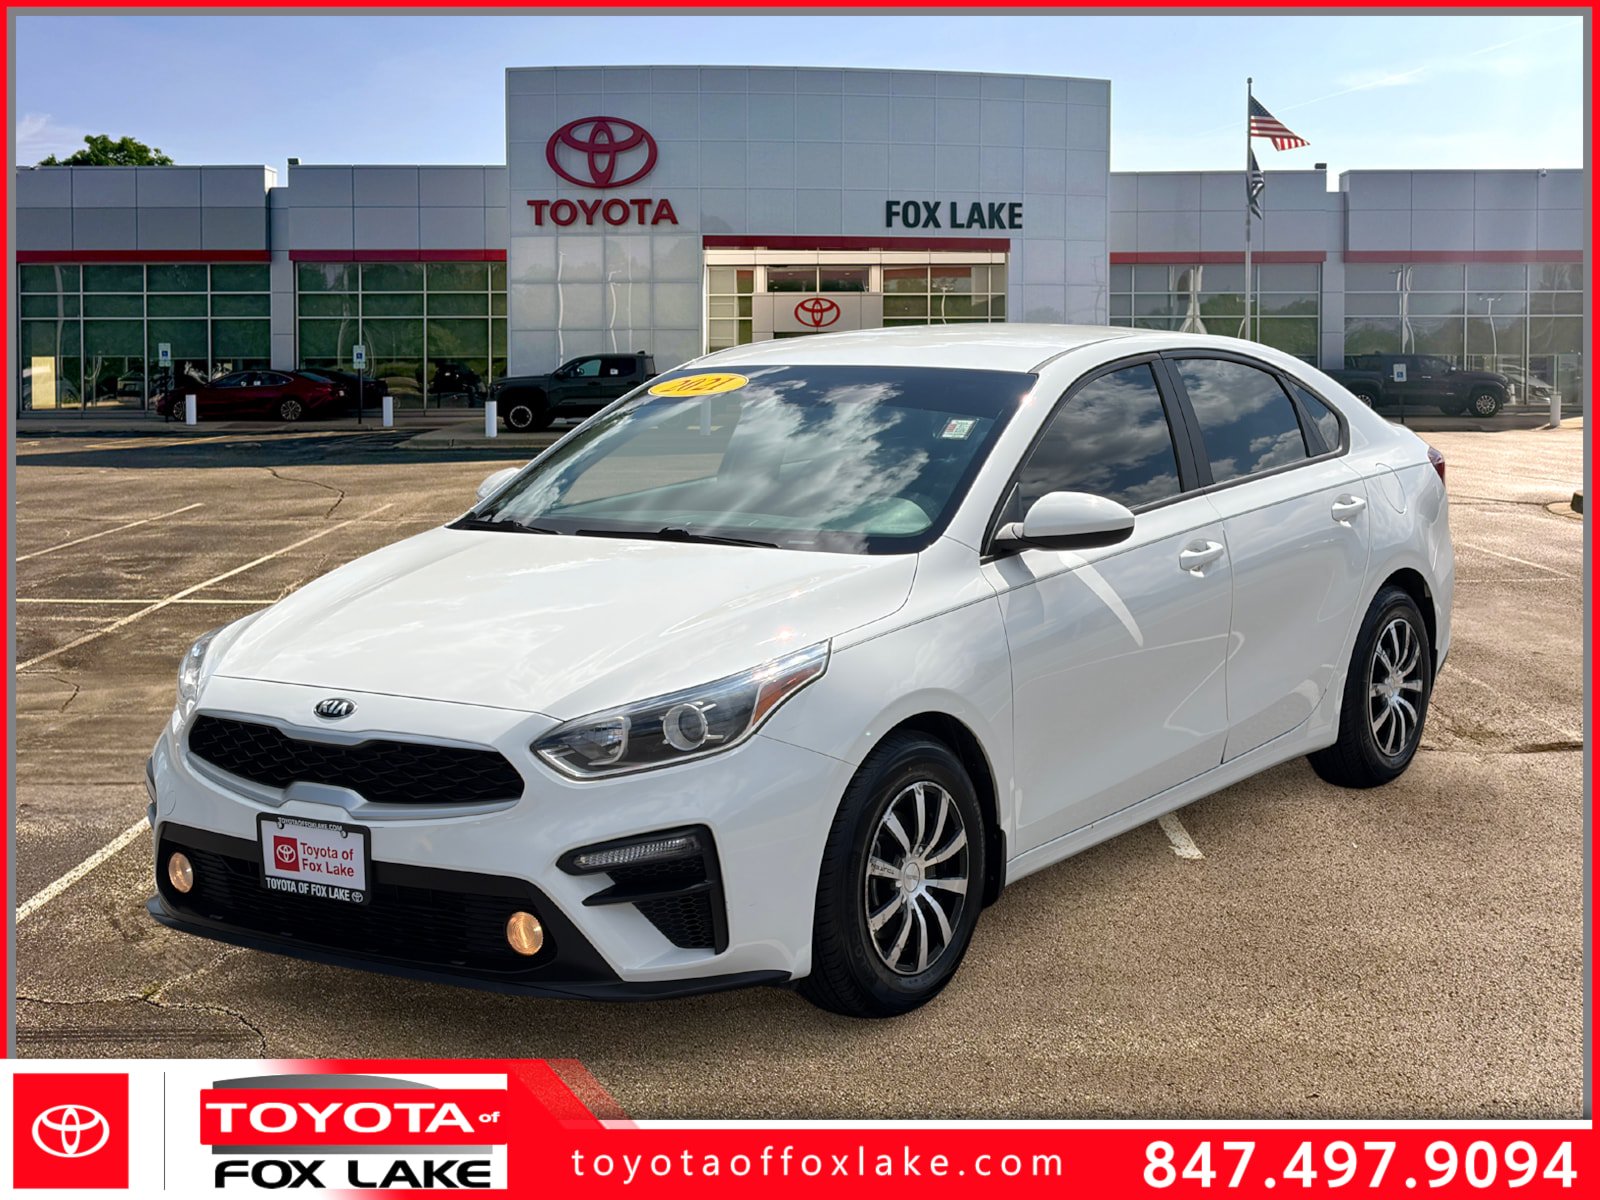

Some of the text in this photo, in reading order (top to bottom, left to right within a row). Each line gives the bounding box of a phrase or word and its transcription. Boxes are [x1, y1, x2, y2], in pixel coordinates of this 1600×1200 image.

[527, 199, 678, 226] TOYOTA
[885, 201, 1023, 229] FOX LAKE
[659, 377, 736, 392] 2021
[317, 700, 349, 715] KIA
[277, 817, 343, 831] TOYOTAOFFOXLAKE.COM
[300, 842, 354, 860] Toyota of
[302, 858, 354, 877] Fox Lake
[265, 877, 351, 901] TOYOTA OF FOX LAKE
